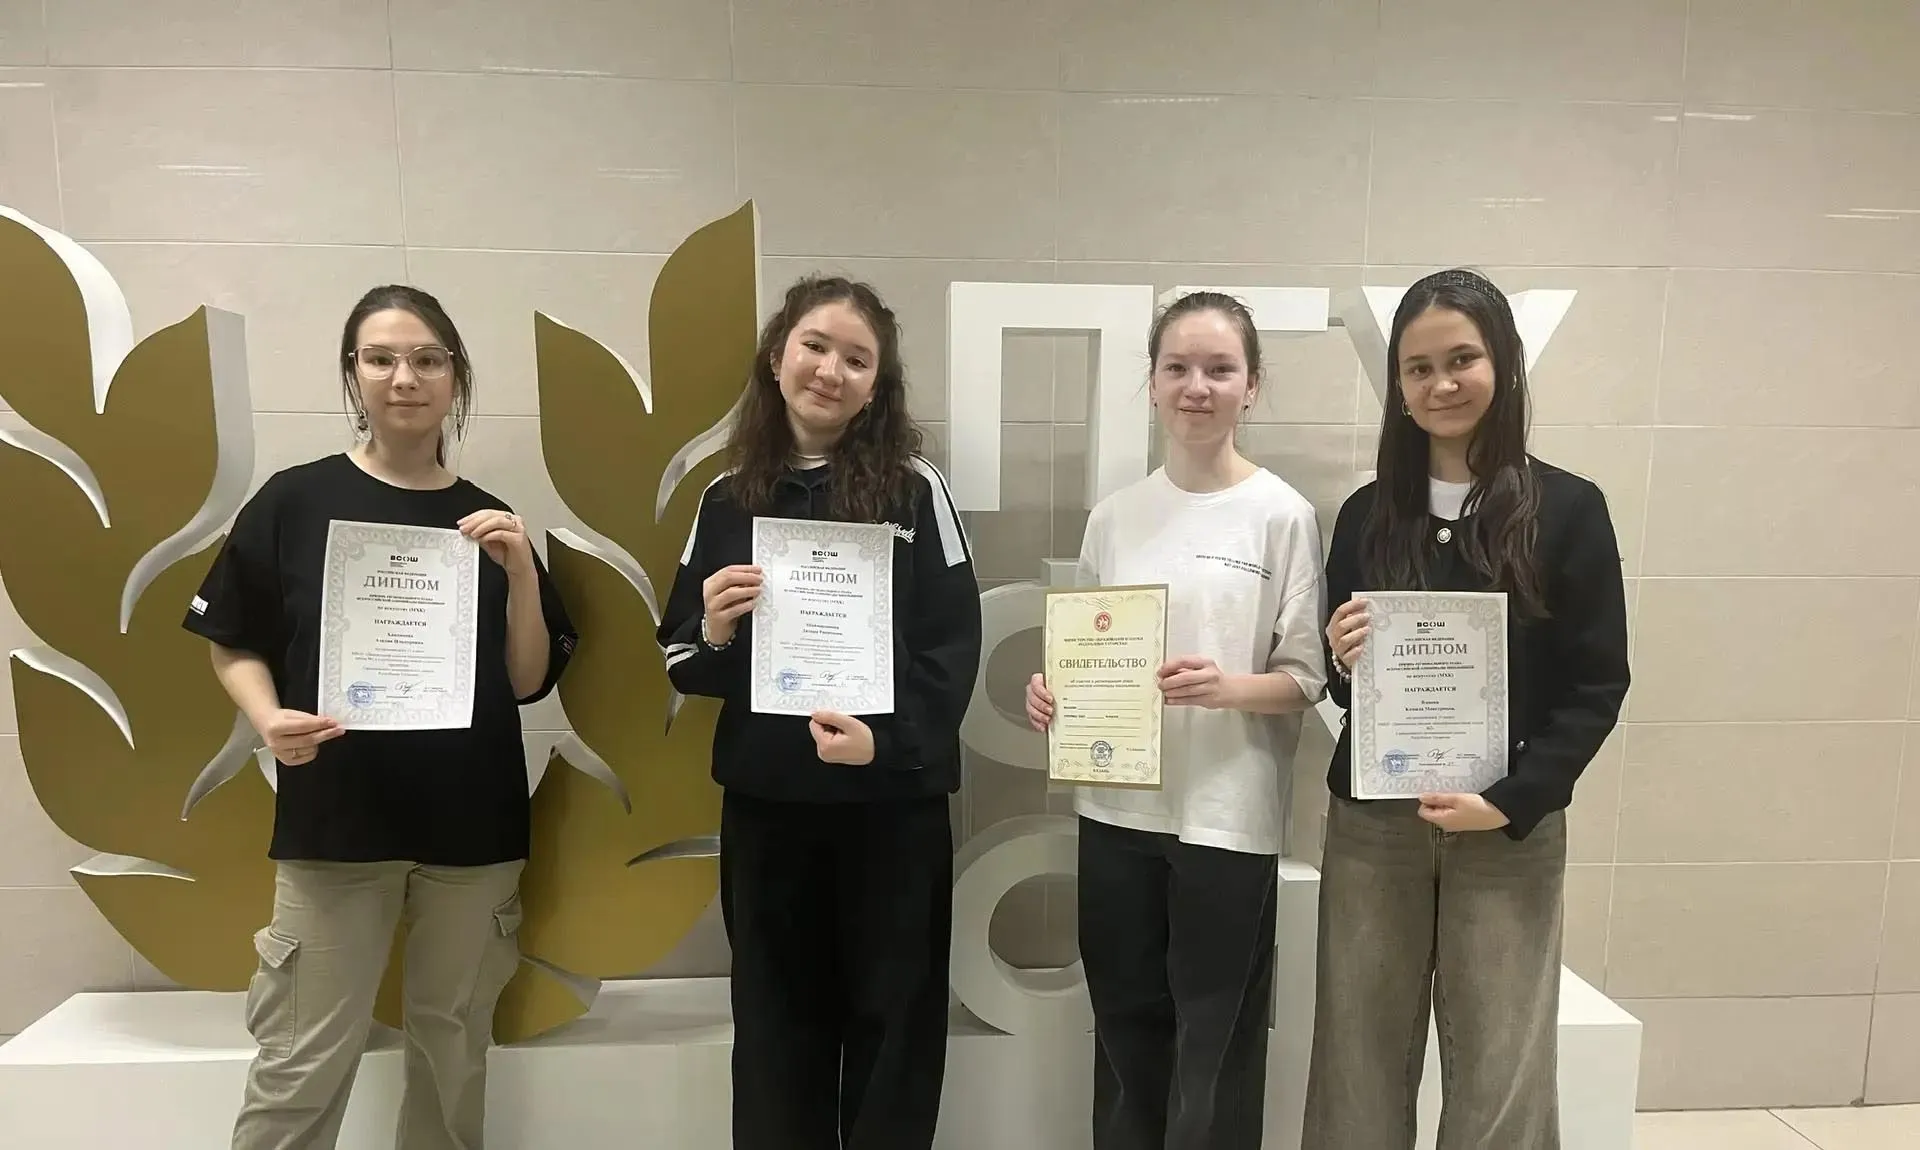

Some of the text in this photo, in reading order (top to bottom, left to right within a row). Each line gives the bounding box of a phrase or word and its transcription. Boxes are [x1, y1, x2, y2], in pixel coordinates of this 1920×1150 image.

[364, 576, 440, 591] ДИПЛОМ
[790, 570, 857, 584] ДИПЛОМ
[1392, 644, 1467, 656] ДИПЛОМ
[1059, 658, 1147, 669] СВИДЕТЕЛЬСТВО
